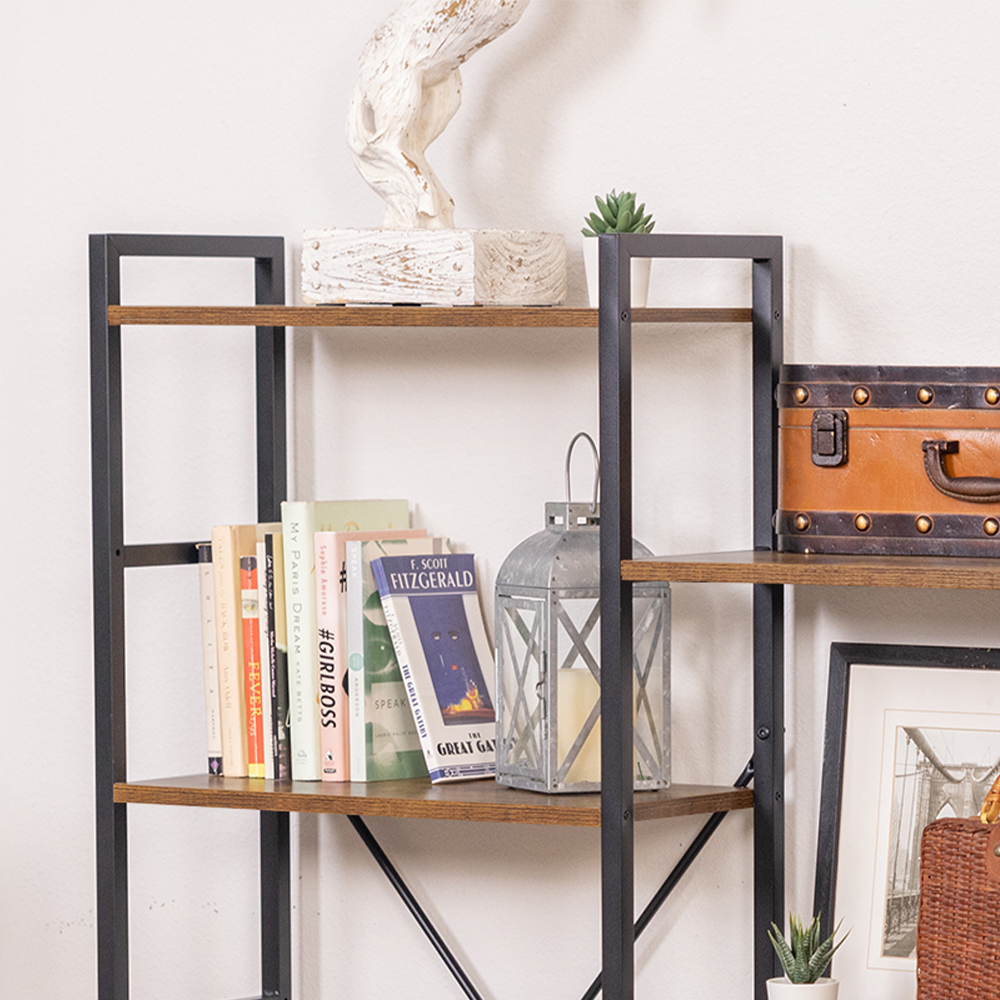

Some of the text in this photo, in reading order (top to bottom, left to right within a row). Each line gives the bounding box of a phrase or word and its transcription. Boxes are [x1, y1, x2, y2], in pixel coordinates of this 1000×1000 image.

[350, 547, 358, 578] SPEAK
[410, 558, 448, 570] F. SCOTT
[290, 522, 303, 654] MY PARIS DREAM
[390, 570, 473, 590] FITZGERALD
[248, 661, 262, 717] FEVER
[318, 628, 337, 728] #GIRLBOSS
[374, 698, 407, 710] SPEAK
[407, 681, 419, 707] GREAT
[414, 708, 427, 739] GATSBY
[248, 718, 257, 736] 1793
[437, 741, 474, 756] GREAT
